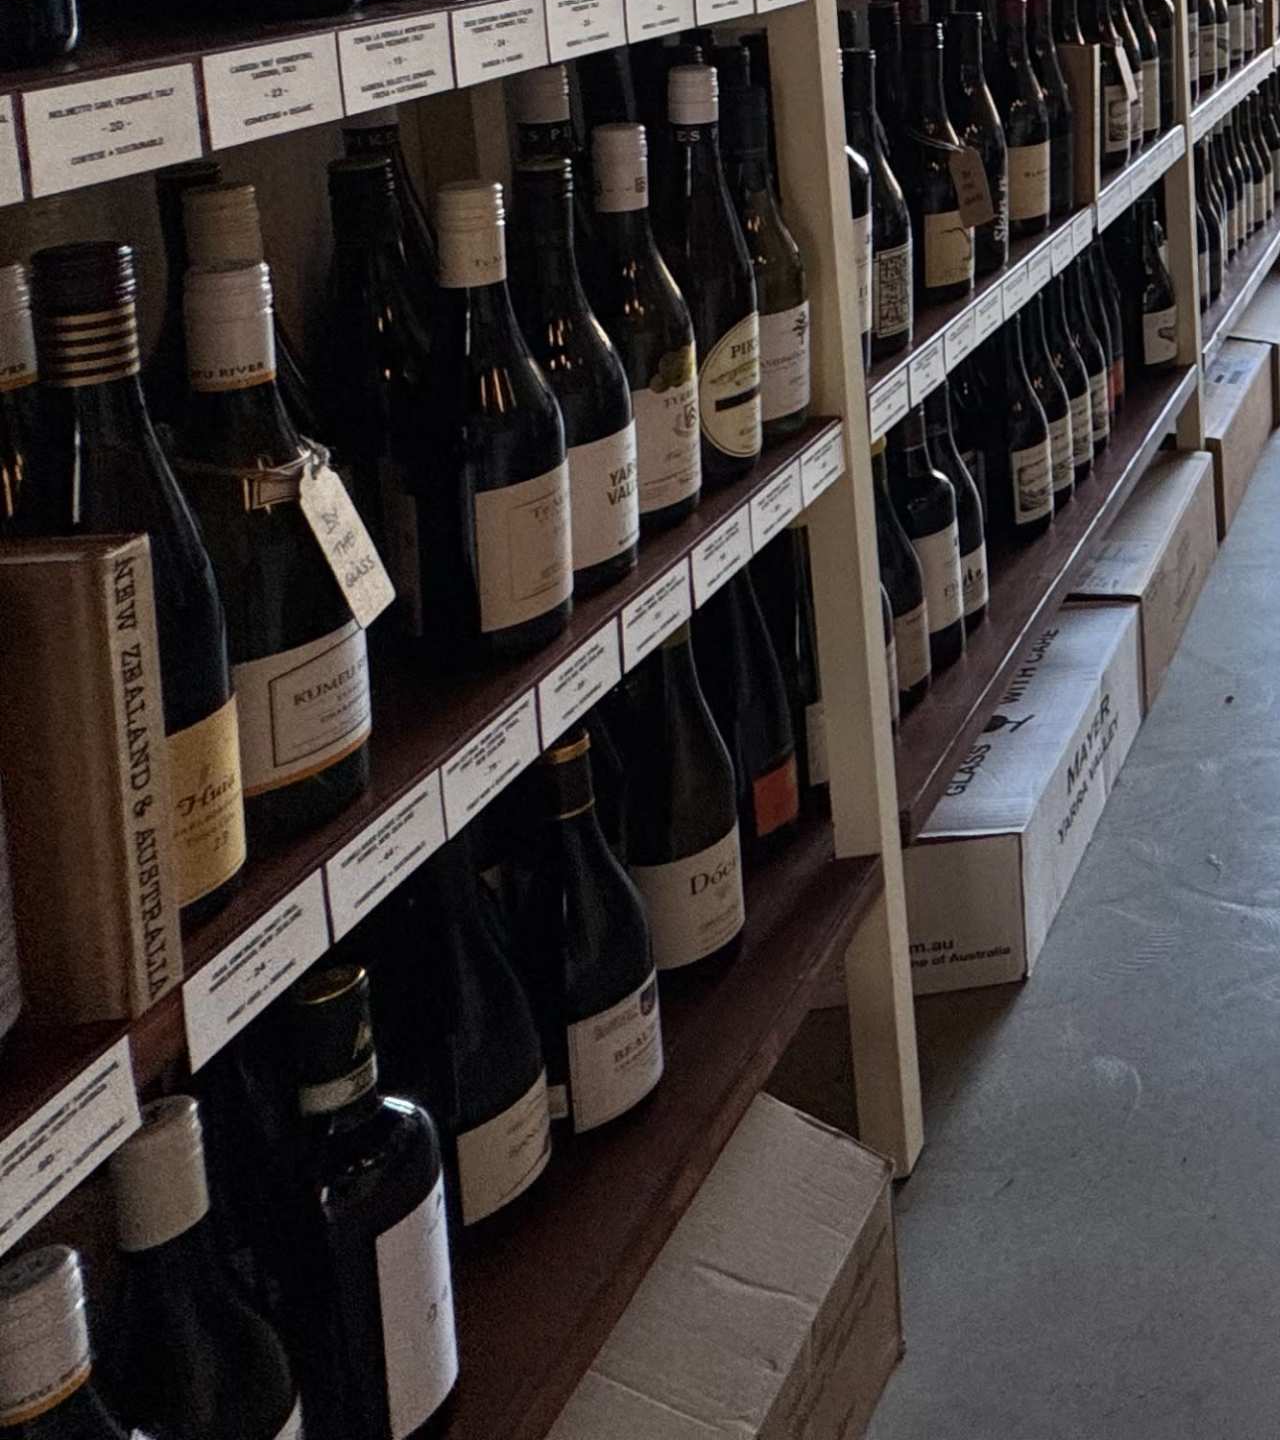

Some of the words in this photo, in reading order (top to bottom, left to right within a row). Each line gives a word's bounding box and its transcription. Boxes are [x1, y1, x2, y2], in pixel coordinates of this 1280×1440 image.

[331, 529, 356, 557] THE
[112, 555, 138, 631] NEW
[121, 643, 153, 794] ZEALAND
[945, 742, 993, 798] GLASS
[1001, 664, 1039, 706] WITH
[1066, 692, 1112, 796] MAYER
[131, 796, 148, 817] &
[133, 823, 172, 1001] AUSTRALIA
[931, 954, 946, 967] of
[948, 945, 1012, 967] Australia
